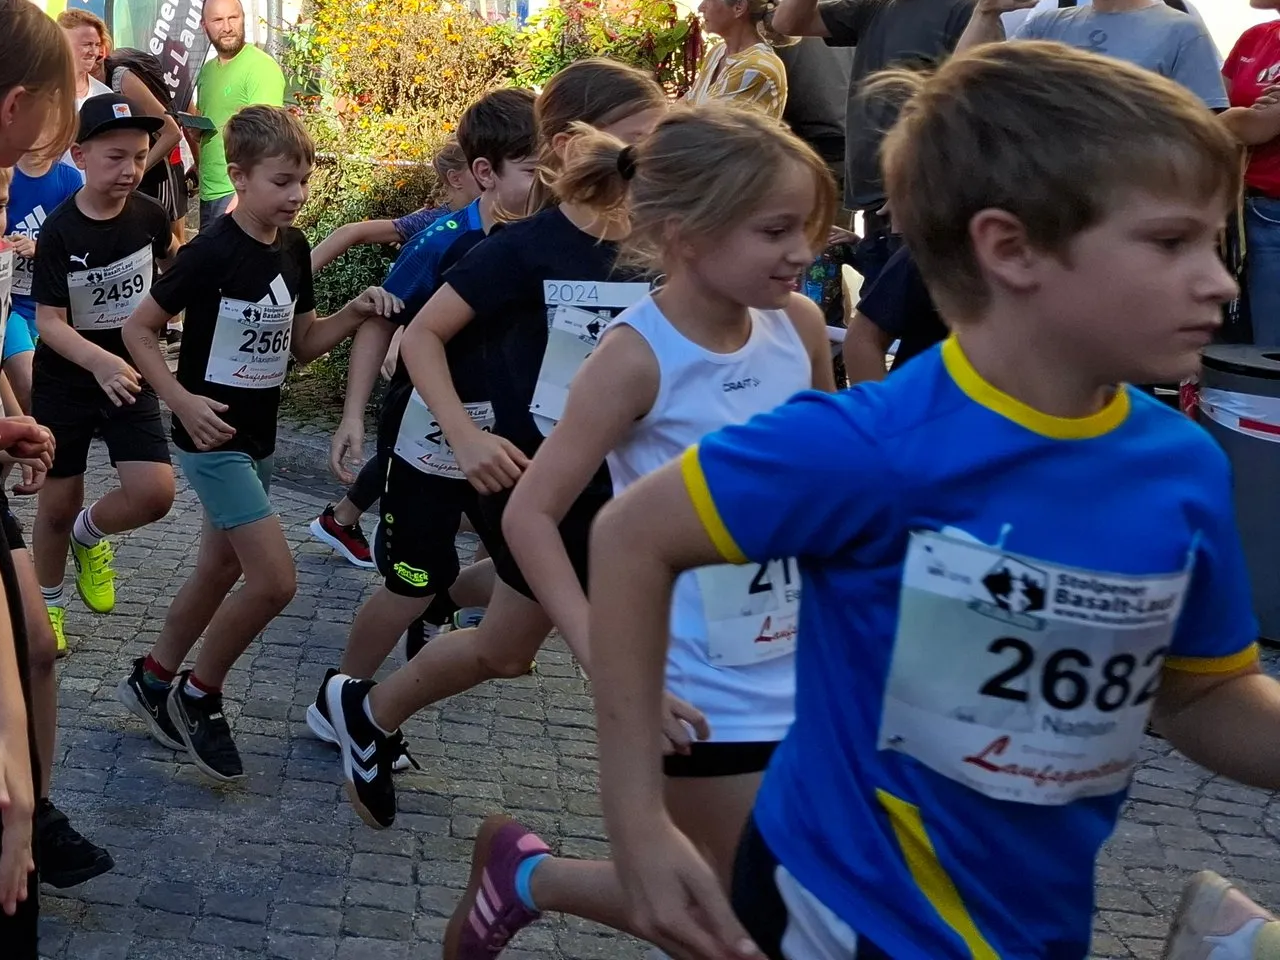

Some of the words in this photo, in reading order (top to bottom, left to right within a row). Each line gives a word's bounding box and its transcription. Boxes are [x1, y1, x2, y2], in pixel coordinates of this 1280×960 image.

[92, 274, 144, 307] 2459
[547, 283, 599, 303] 2024
[115, 300, 130, 309] Paul
[239, 328, 290, 354] 2566
[723, 379, 752, 392] CRAFT
[1056, 573, 1148, 596] Stolpener
[1053, 590, 1176, 614] Basalt-Lauf
[978, 636, 1171, 714] 2682
